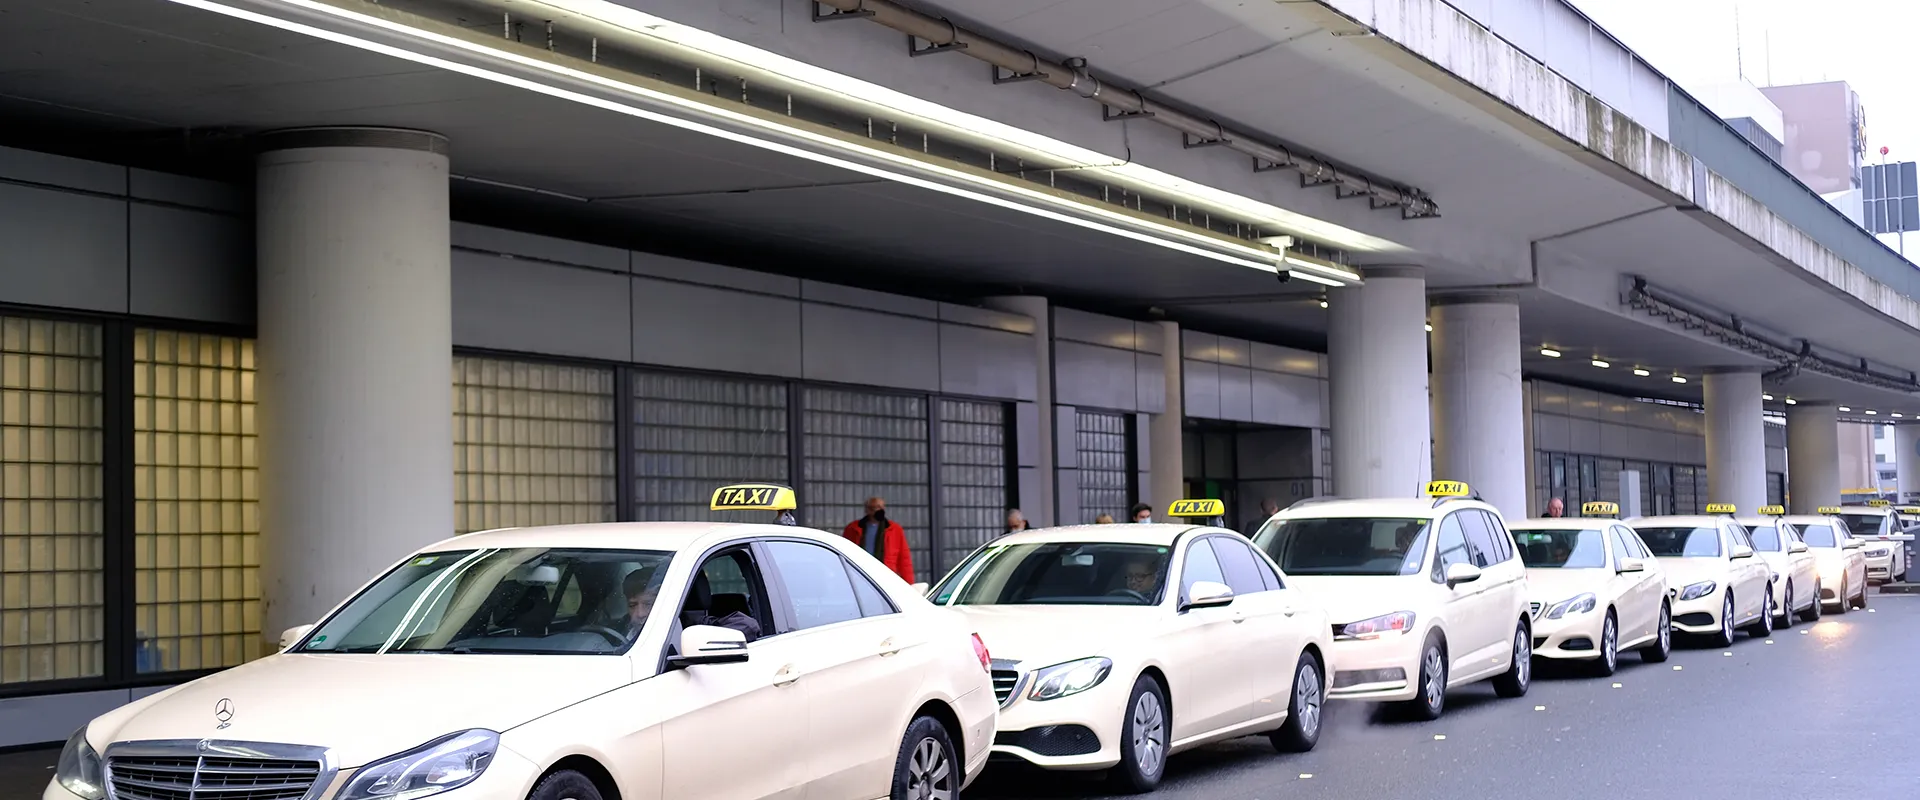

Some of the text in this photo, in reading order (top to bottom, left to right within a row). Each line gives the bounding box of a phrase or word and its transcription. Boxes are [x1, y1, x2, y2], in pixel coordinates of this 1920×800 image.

[1291, 482, 1305, 497] 01
[1433, 484, 1460, 493] TAXI
[722, 488, 773, 505] TAXI
[1178, 502, 1213, 513] TAXI
[1588, 504, 1611, 512] TAXI
[1711, 504, 1731, 512] TAXI
